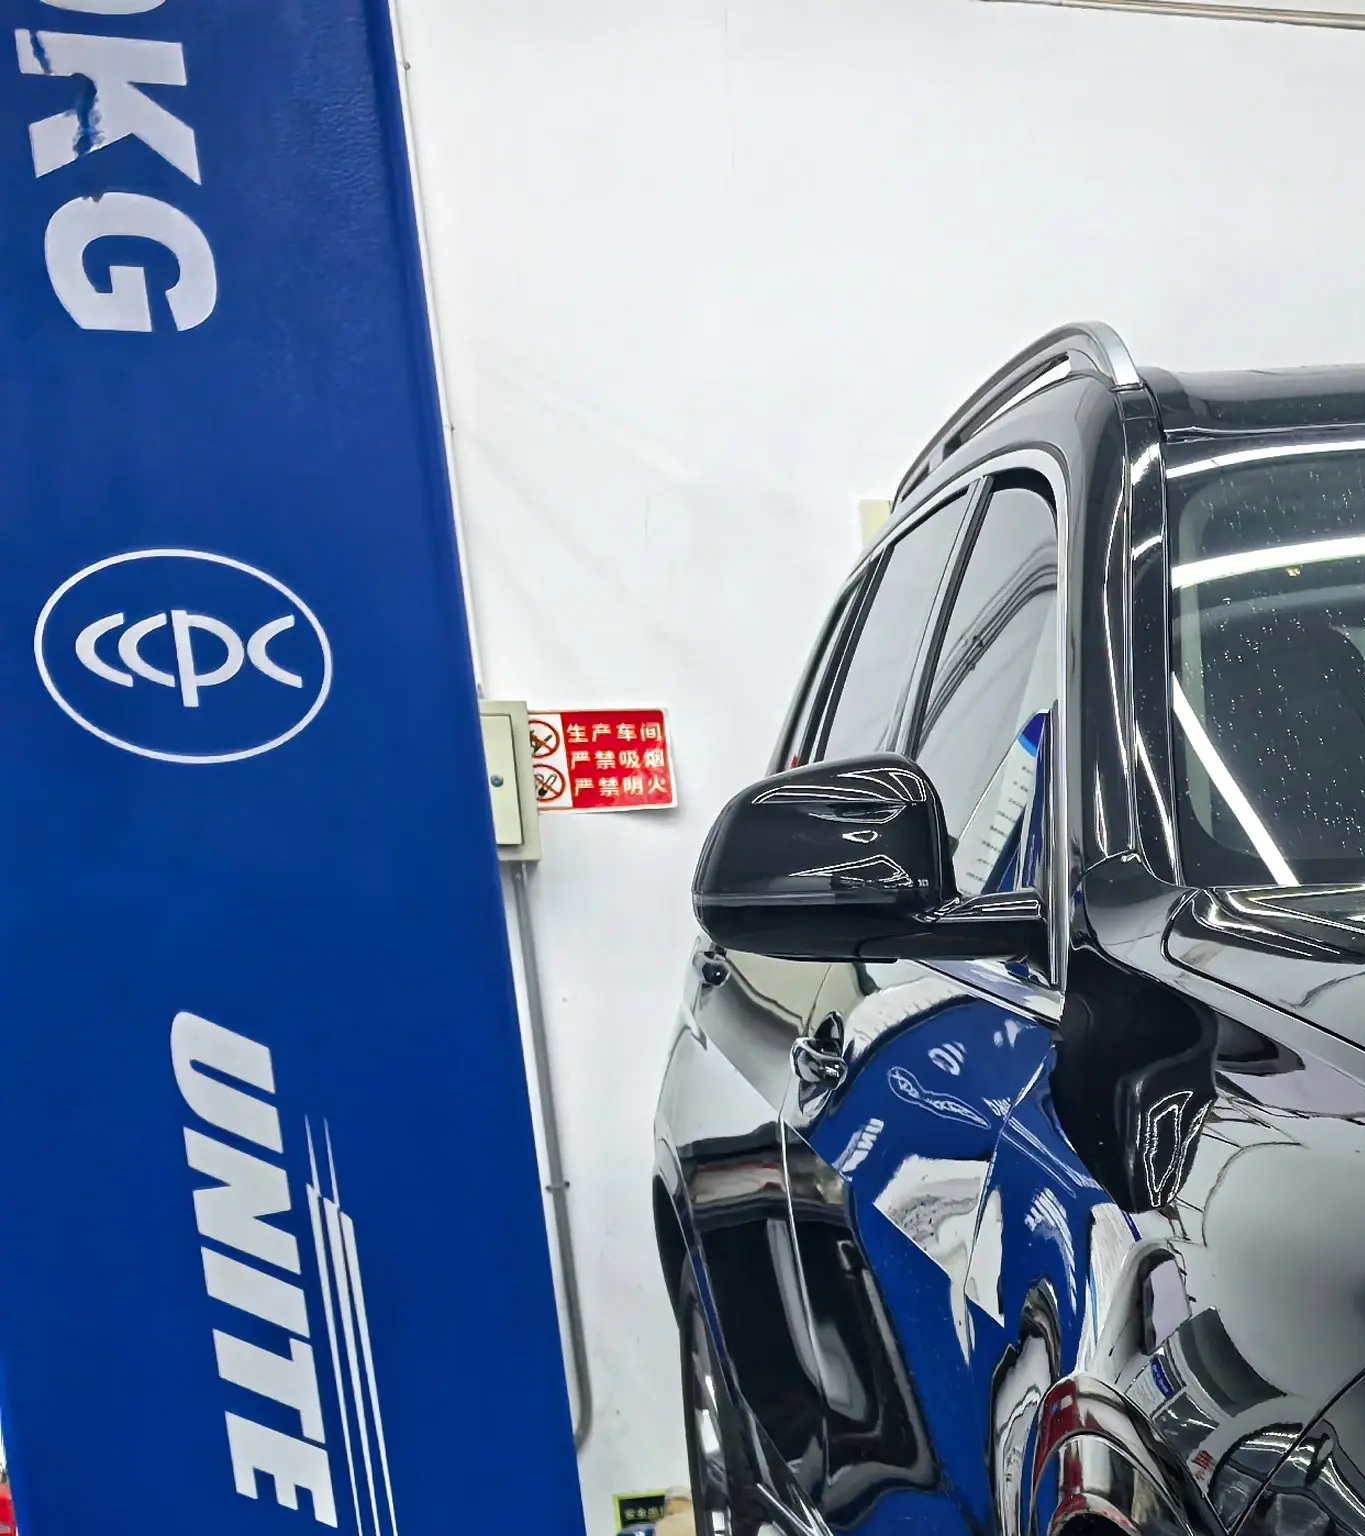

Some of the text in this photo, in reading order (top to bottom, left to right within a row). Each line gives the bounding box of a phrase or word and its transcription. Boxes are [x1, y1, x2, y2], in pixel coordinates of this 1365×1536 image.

[15, 0, 217, 332] KG
[566, 721, 662, 744] 生产车间
[570, 748, 665, 770] 严禁吸烟
[574, 775, 668, 797] 严禁明火
[170, 1010, 338, 1528] UNITE
